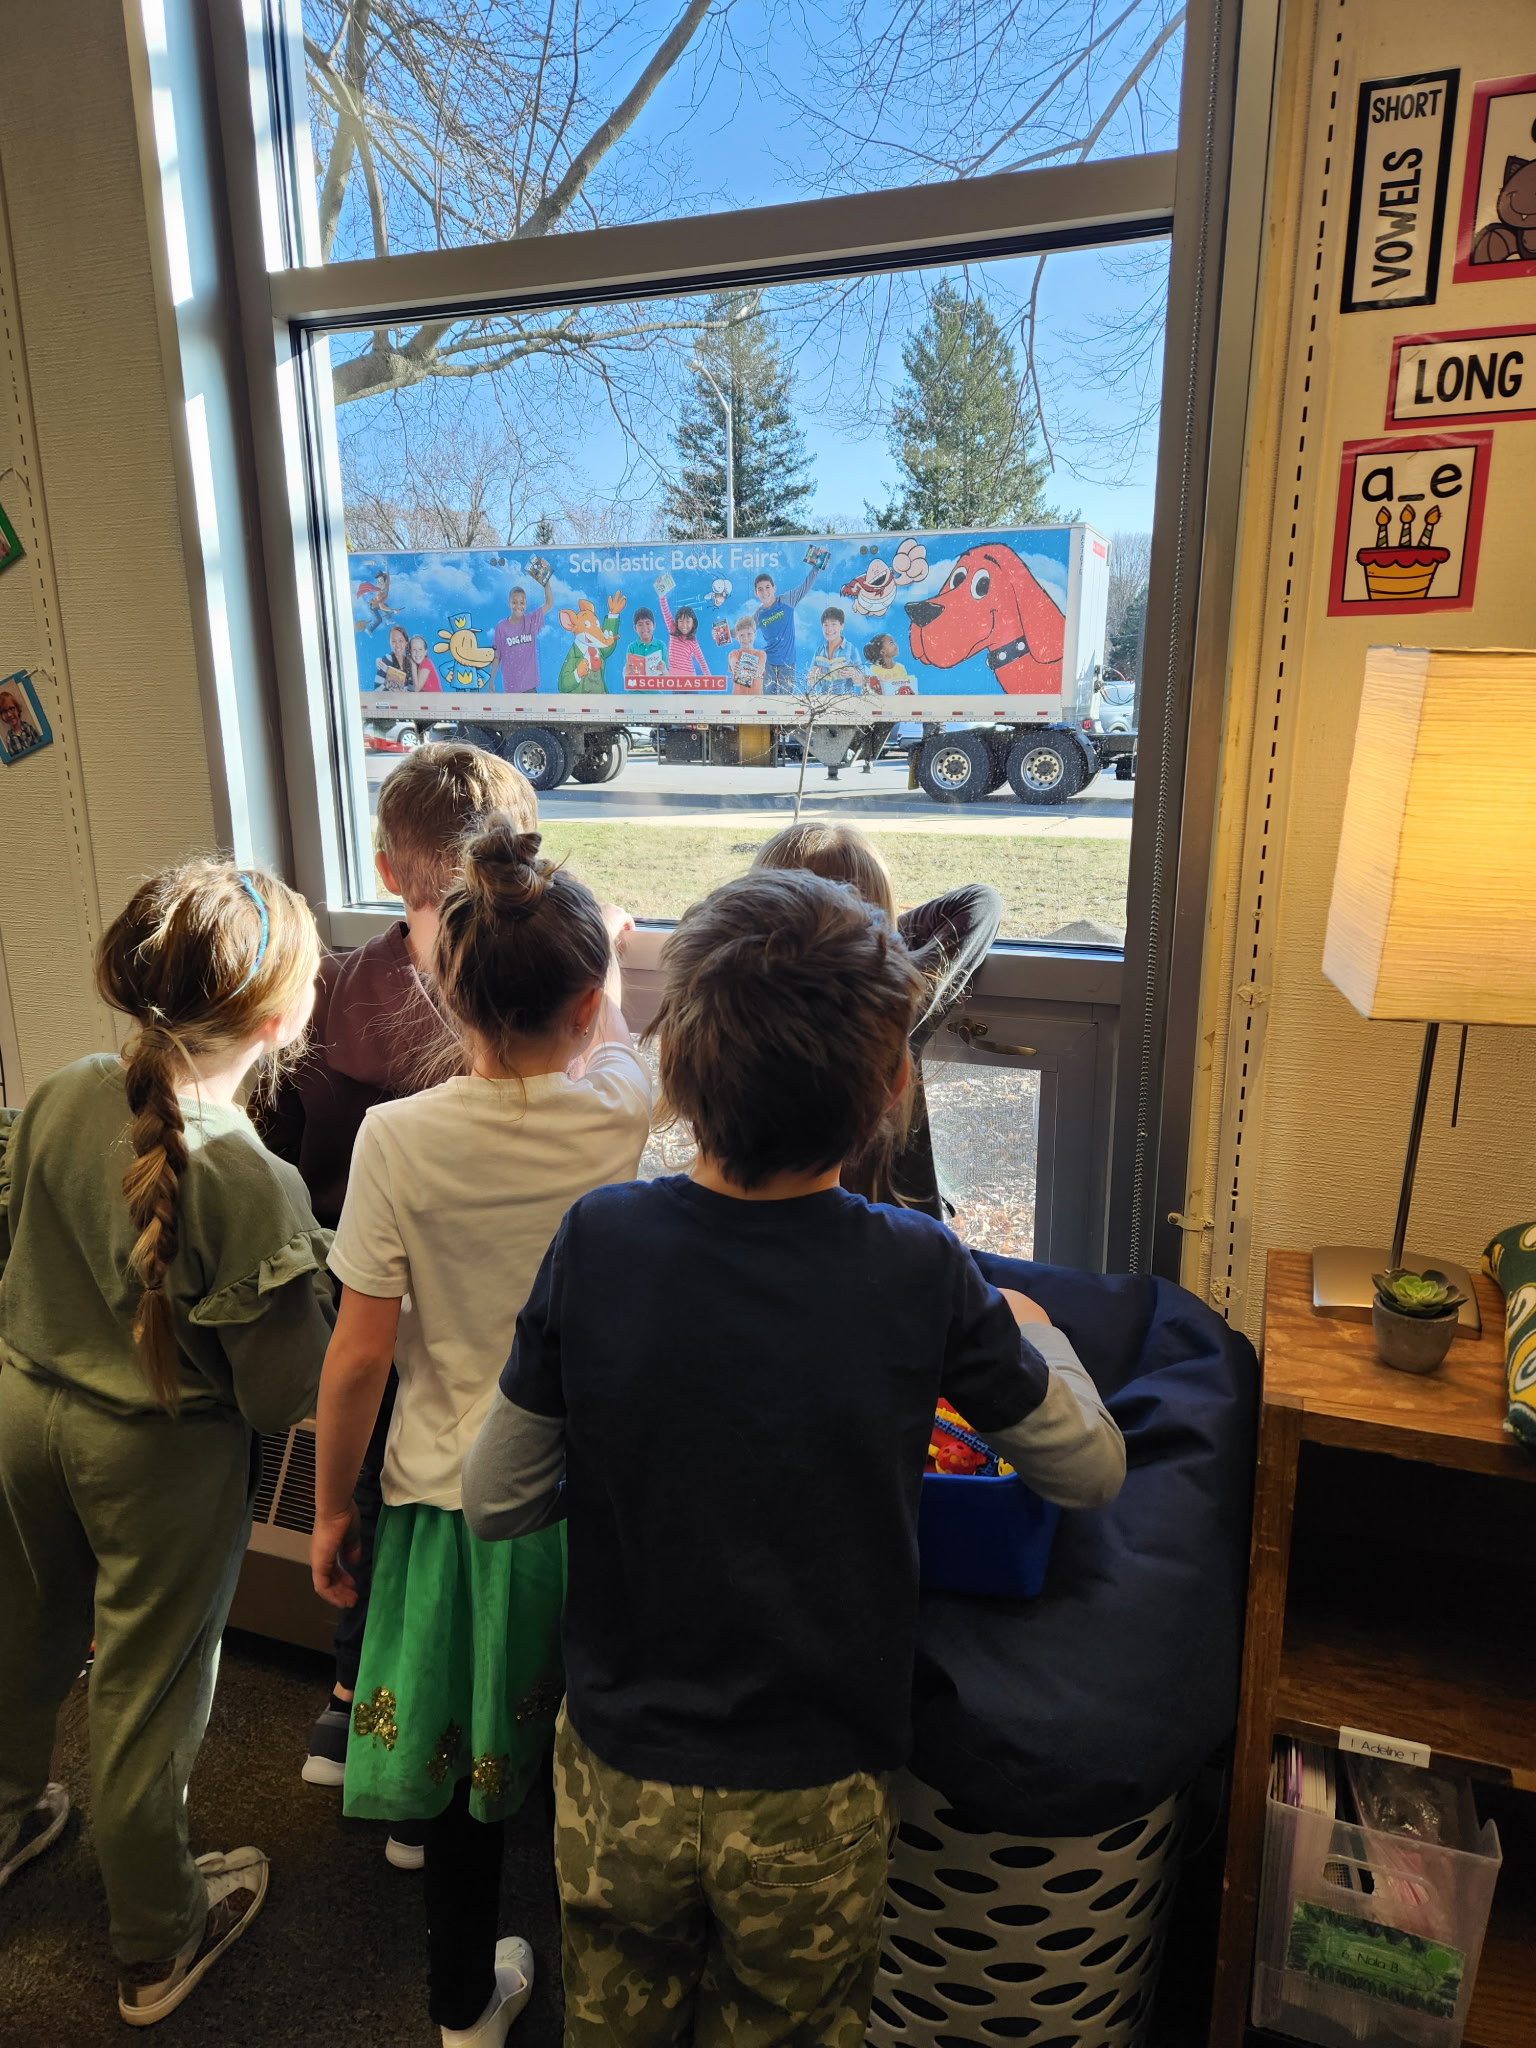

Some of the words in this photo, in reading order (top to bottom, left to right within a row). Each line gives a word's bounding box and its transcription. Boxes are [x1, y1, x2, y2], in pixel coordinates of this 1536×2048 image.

[1372, 89, 1442, 123] SHORT
[1371, 148, 1423, 288] VOWELS
[1414, 351, 1524, 404] LONG
[569, 552, 665, 574] Scholastic
[671, 548, 723, 570] Book
[730, 547, 779, 569] Fairs
[639, 679, 725, 688] SCHOLASTIC
[1361, 1741, 1405, 1759] Adeline
[1411, 1751, 1419, 1761] T
[1358, 1952, 1386, 1970] Nola
